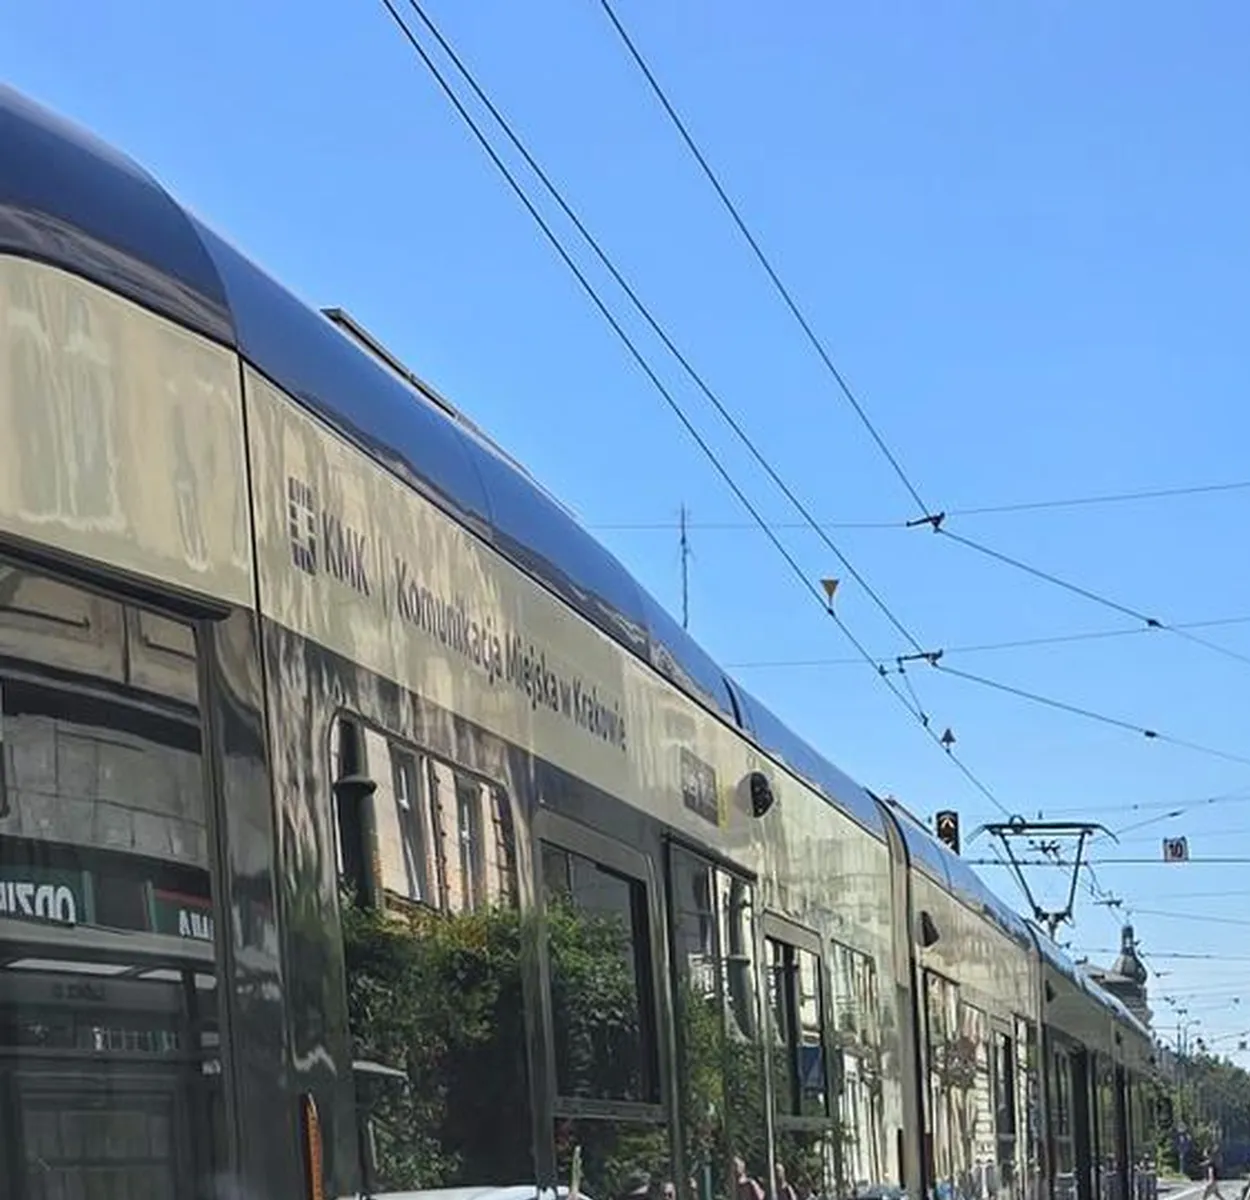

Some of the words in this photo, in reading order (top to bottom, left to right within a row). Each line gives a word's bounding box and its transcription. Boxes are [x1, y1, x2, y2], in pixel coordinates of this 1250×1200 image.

[322, 511, 371, 597] KMK
[395, 556, 502, 686] Komunikacja
[505, 631, 560, 711] Miejska
[560, 680, 571, 718] w
[572, 676, 627, 752] Krakowie
